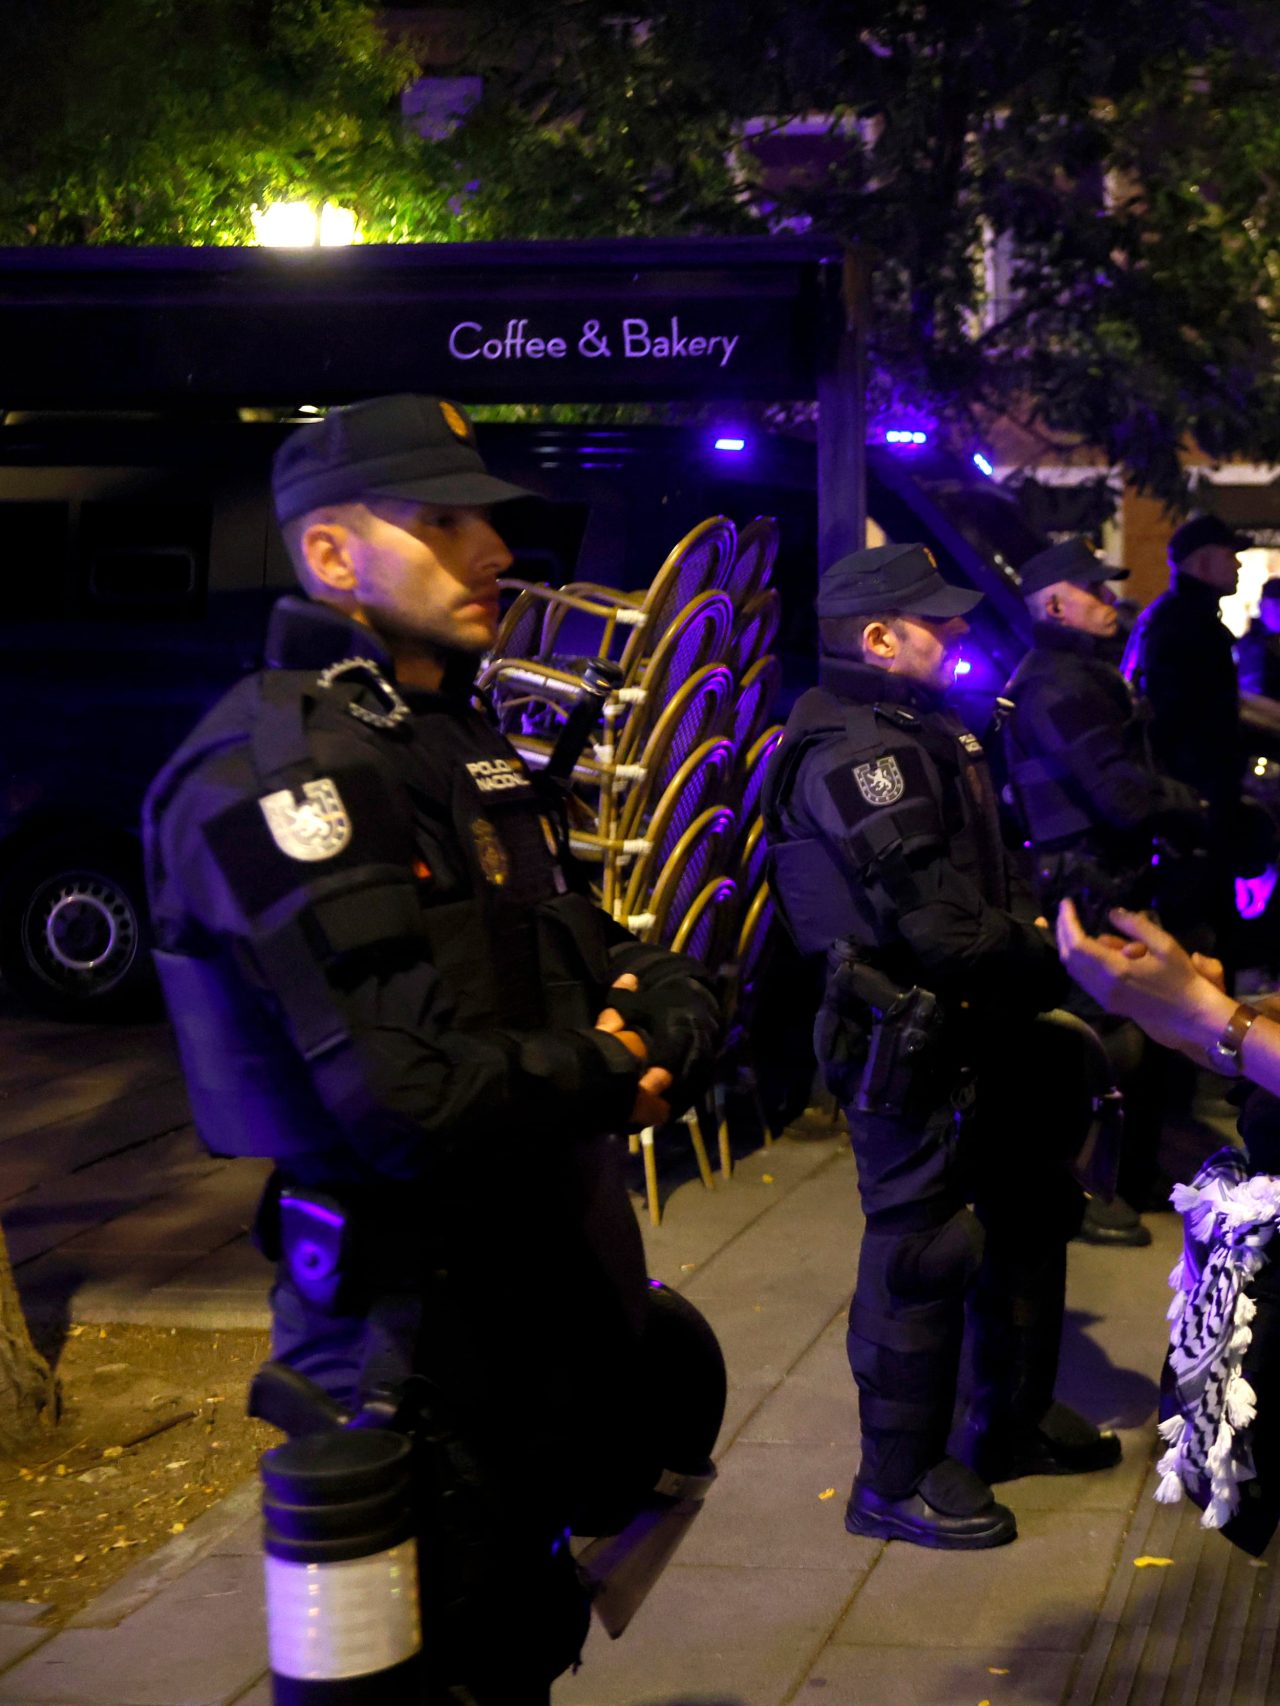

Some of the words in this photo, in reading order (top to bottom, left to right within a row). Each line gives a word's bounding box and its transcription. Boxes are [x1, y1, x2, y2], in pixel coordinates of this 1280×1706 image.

[449, 319, 567, 360] Coffee
[578, 319, 612, 358] &
[622, 316, 739, 367] Bakery
